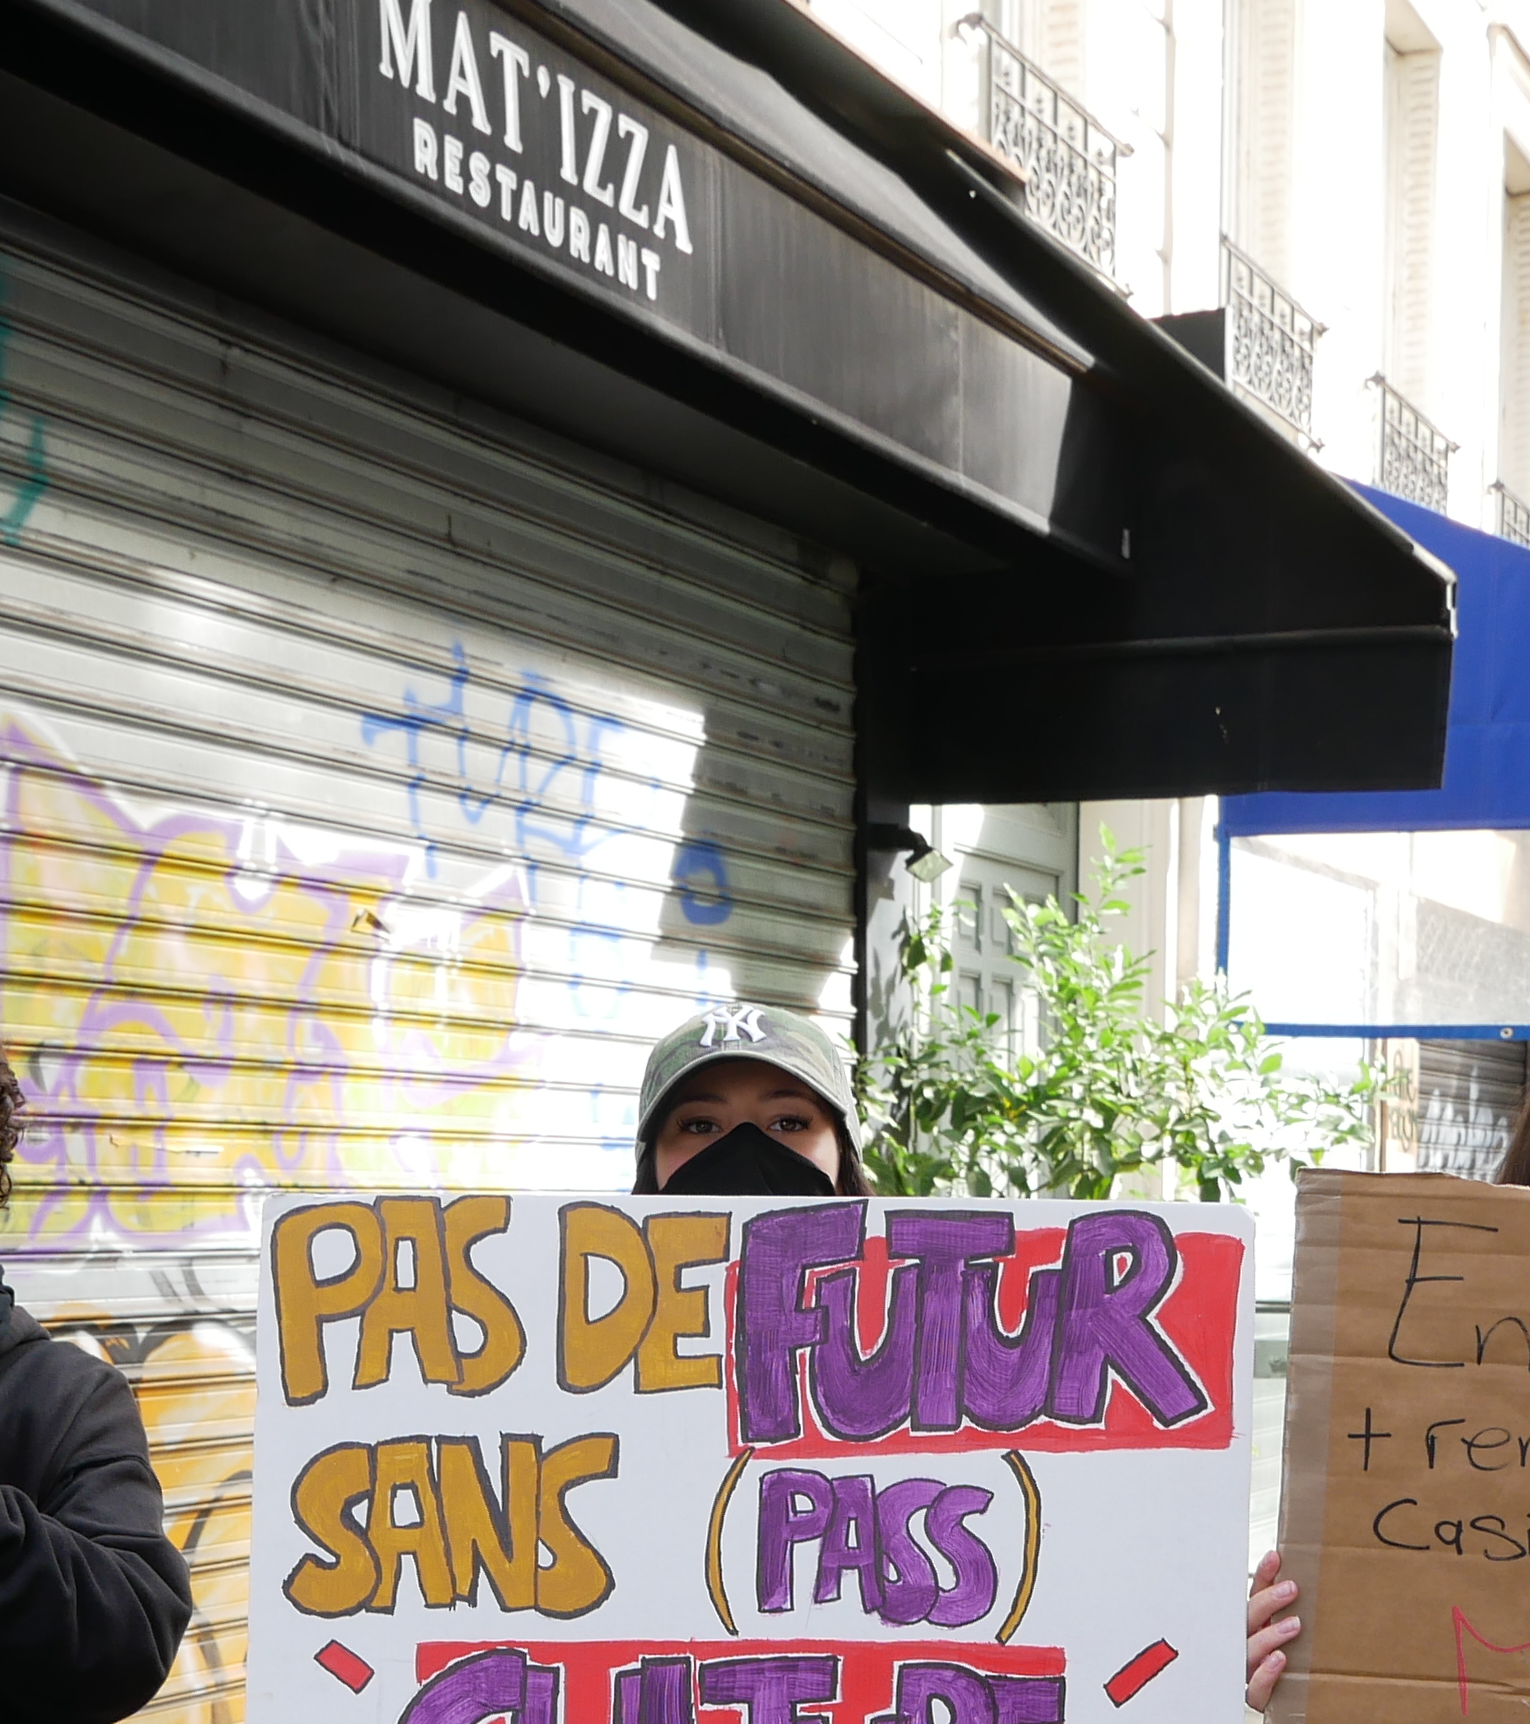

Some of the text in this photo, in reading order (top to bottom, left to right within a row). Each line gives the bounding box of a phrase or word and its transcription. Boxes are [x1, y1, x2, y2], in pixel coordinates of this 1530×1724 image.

[379, 0, 693, 255] MAT'IZZA
[413, 117, 661, 300] RESTAURANT
[270, 1195, 1209, 1444] PAS DE FUTUR
[283, 1433, 1042, 1644] SANS (PASS)
